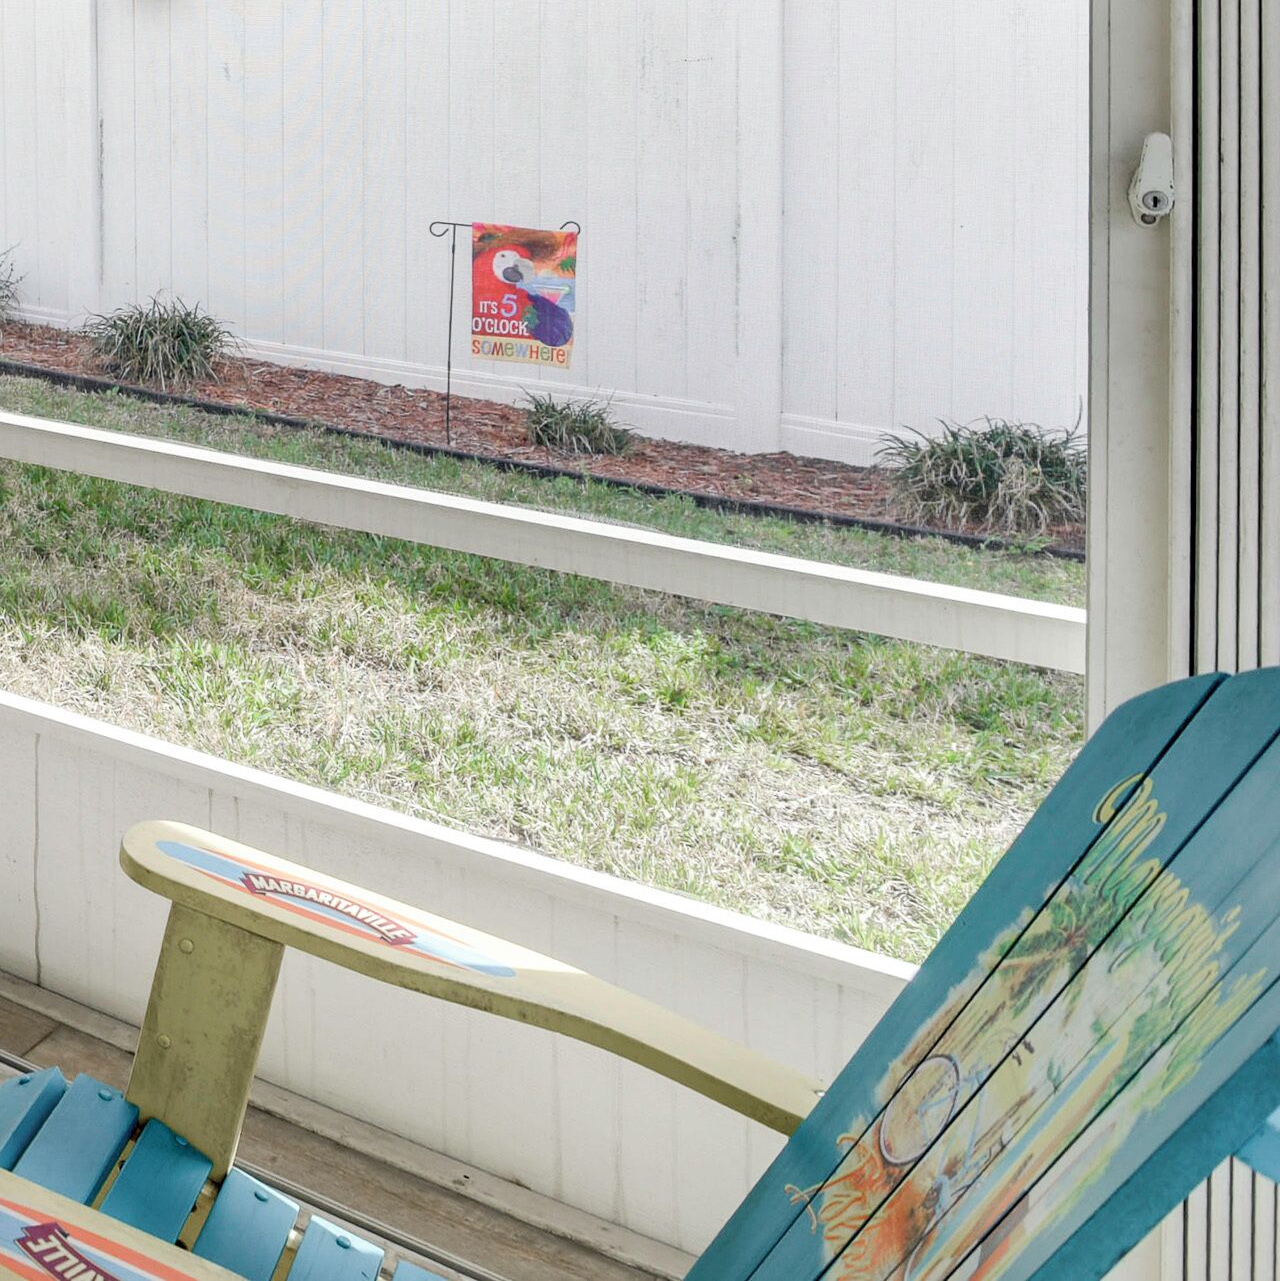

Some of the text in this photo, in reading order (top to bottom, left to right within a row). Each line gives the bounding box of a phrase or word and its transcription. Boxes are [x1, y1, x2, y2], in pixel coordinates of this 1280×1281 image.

[478, 293, 518, 318] IT'S 5
[472, 317, 530, 336] O'CLOCK
[249, 875, 410, 940] MARGARITAVILLE
